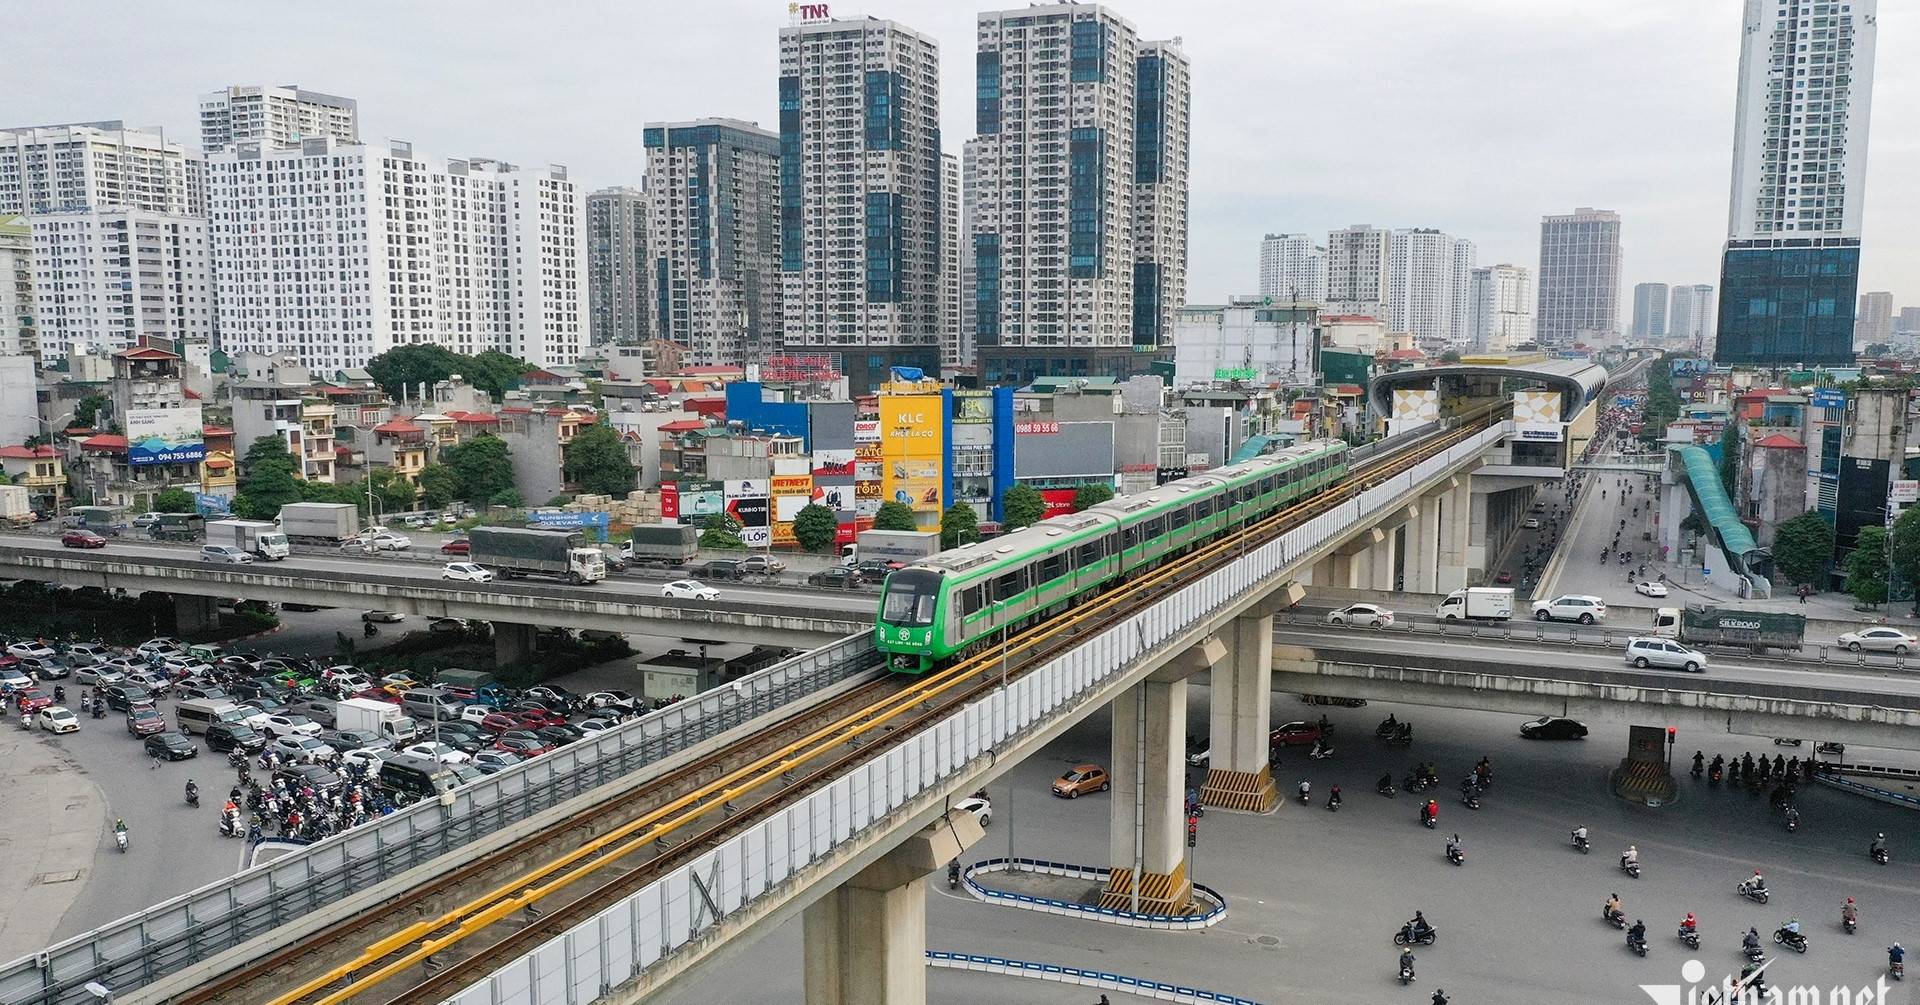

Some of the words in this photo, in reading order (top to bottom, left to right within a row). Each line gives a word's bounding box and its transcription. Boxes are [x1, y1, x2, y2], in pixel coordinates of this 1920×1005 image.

[800, 4, 829, 19] TNR
[898, 413, 924, 423] KLC
[1016, 424, 1031, 433] 0988
[1033, 424, 1041, 433] 59
[1042, 423, 1050, 433] 55
[158, 453, 172, 461] 094
[173, 452, 184, 460] 755
[186, 451, 203, 459] 6886
[772, 478, 810, 487] VIETNEST
[856, 485, 883, 494] TOPY
[748, 531, 767, 542] LỐP
[1719, 619, 1760, 629] SILKROAD
